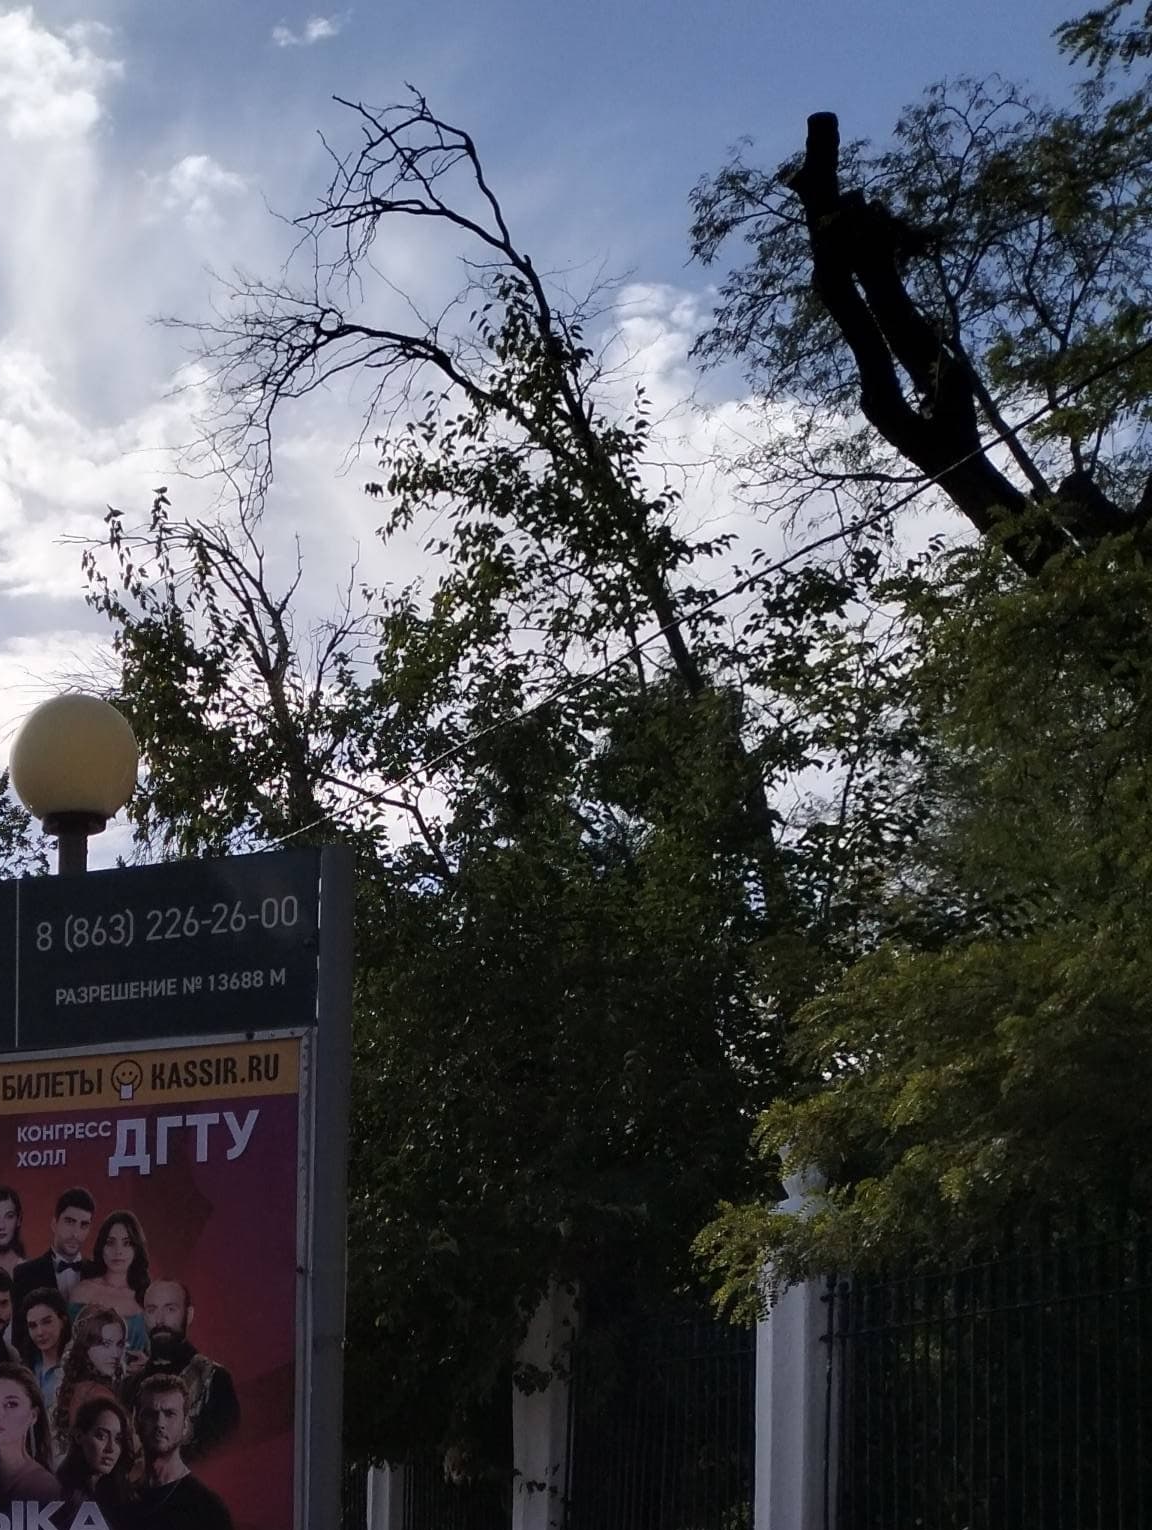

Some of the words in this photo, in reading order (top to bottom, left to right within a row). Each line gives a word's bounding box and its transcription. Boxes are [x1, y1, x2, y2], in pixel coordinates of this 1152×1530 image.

[36, 922, 52, 951] 8
[65, 909, 134, 952] (863)
[146, 896, 298, 940] 226-26-00
[55, 979, 176, 1005] РАЗРЕШЕНИЕ
[182, 975, 202, 995] №
[207, 971, 264, 992] 13688
[2, 1068, 102, 1101] БИЛЕТЫ
[152, 1053, 279, 1090] KASSIR.RU
[17, 1121, 111, 1142] КОНГРЕСС
[109, 1110, 259, 1176] ДГТУ
[17, 1147, 66, 1168] ХОЛЛ
